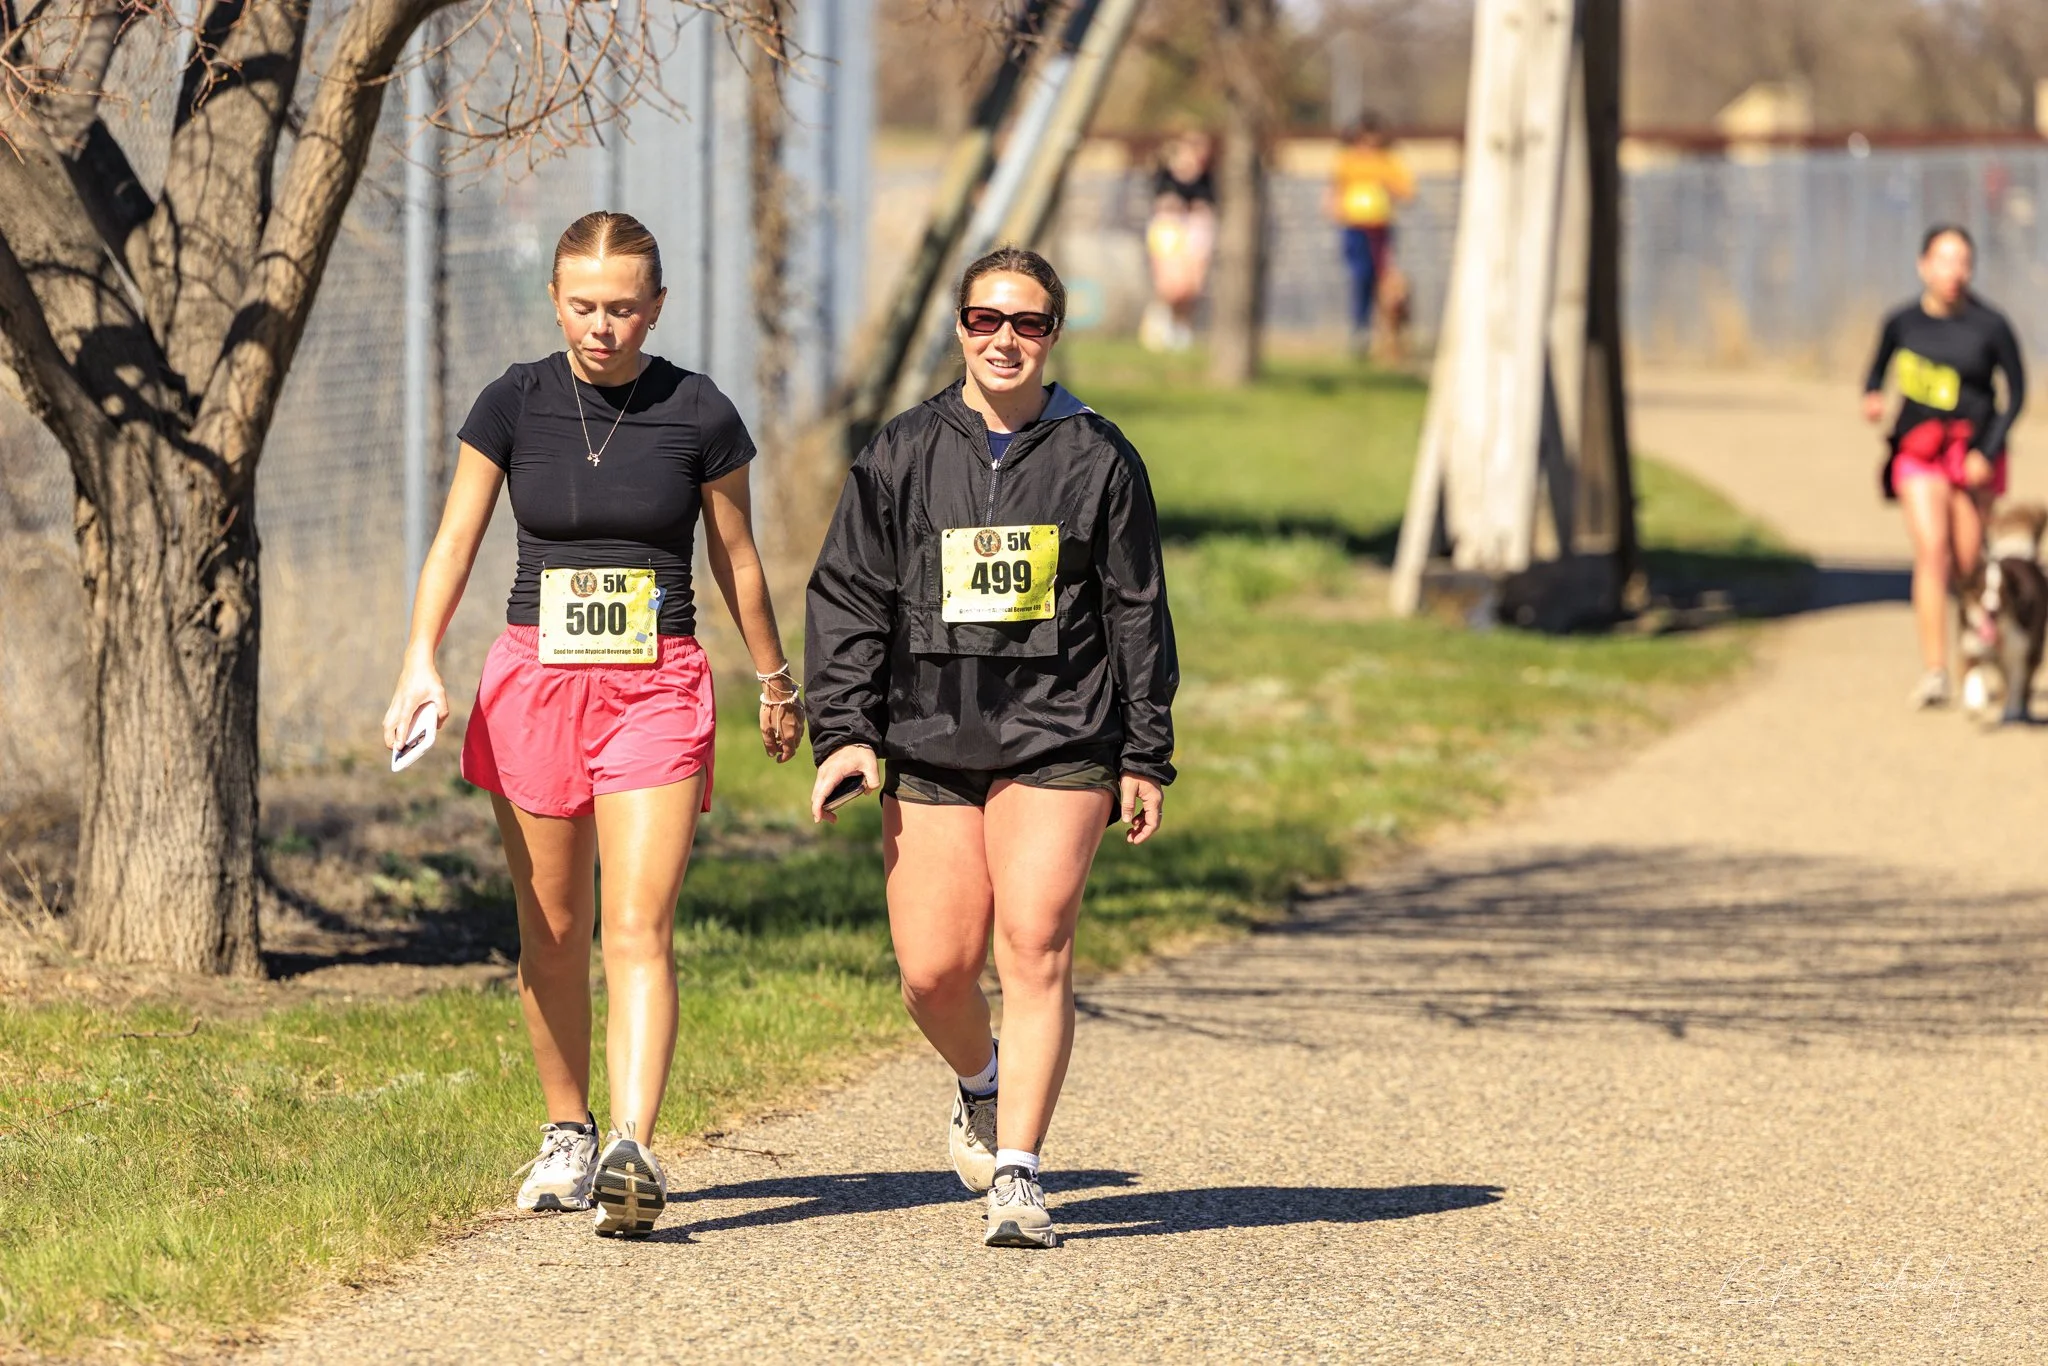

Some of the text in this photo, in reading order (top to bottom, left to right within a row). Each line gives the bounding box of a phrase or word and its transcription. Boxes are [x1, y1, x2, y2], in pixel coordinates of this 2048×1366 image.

[1007, 532, 1031, 551] 5K
[603, 574, 627, 593] 5K
[971, 560, 1032, 594] 499
[566, 602, 627, 636] 500
